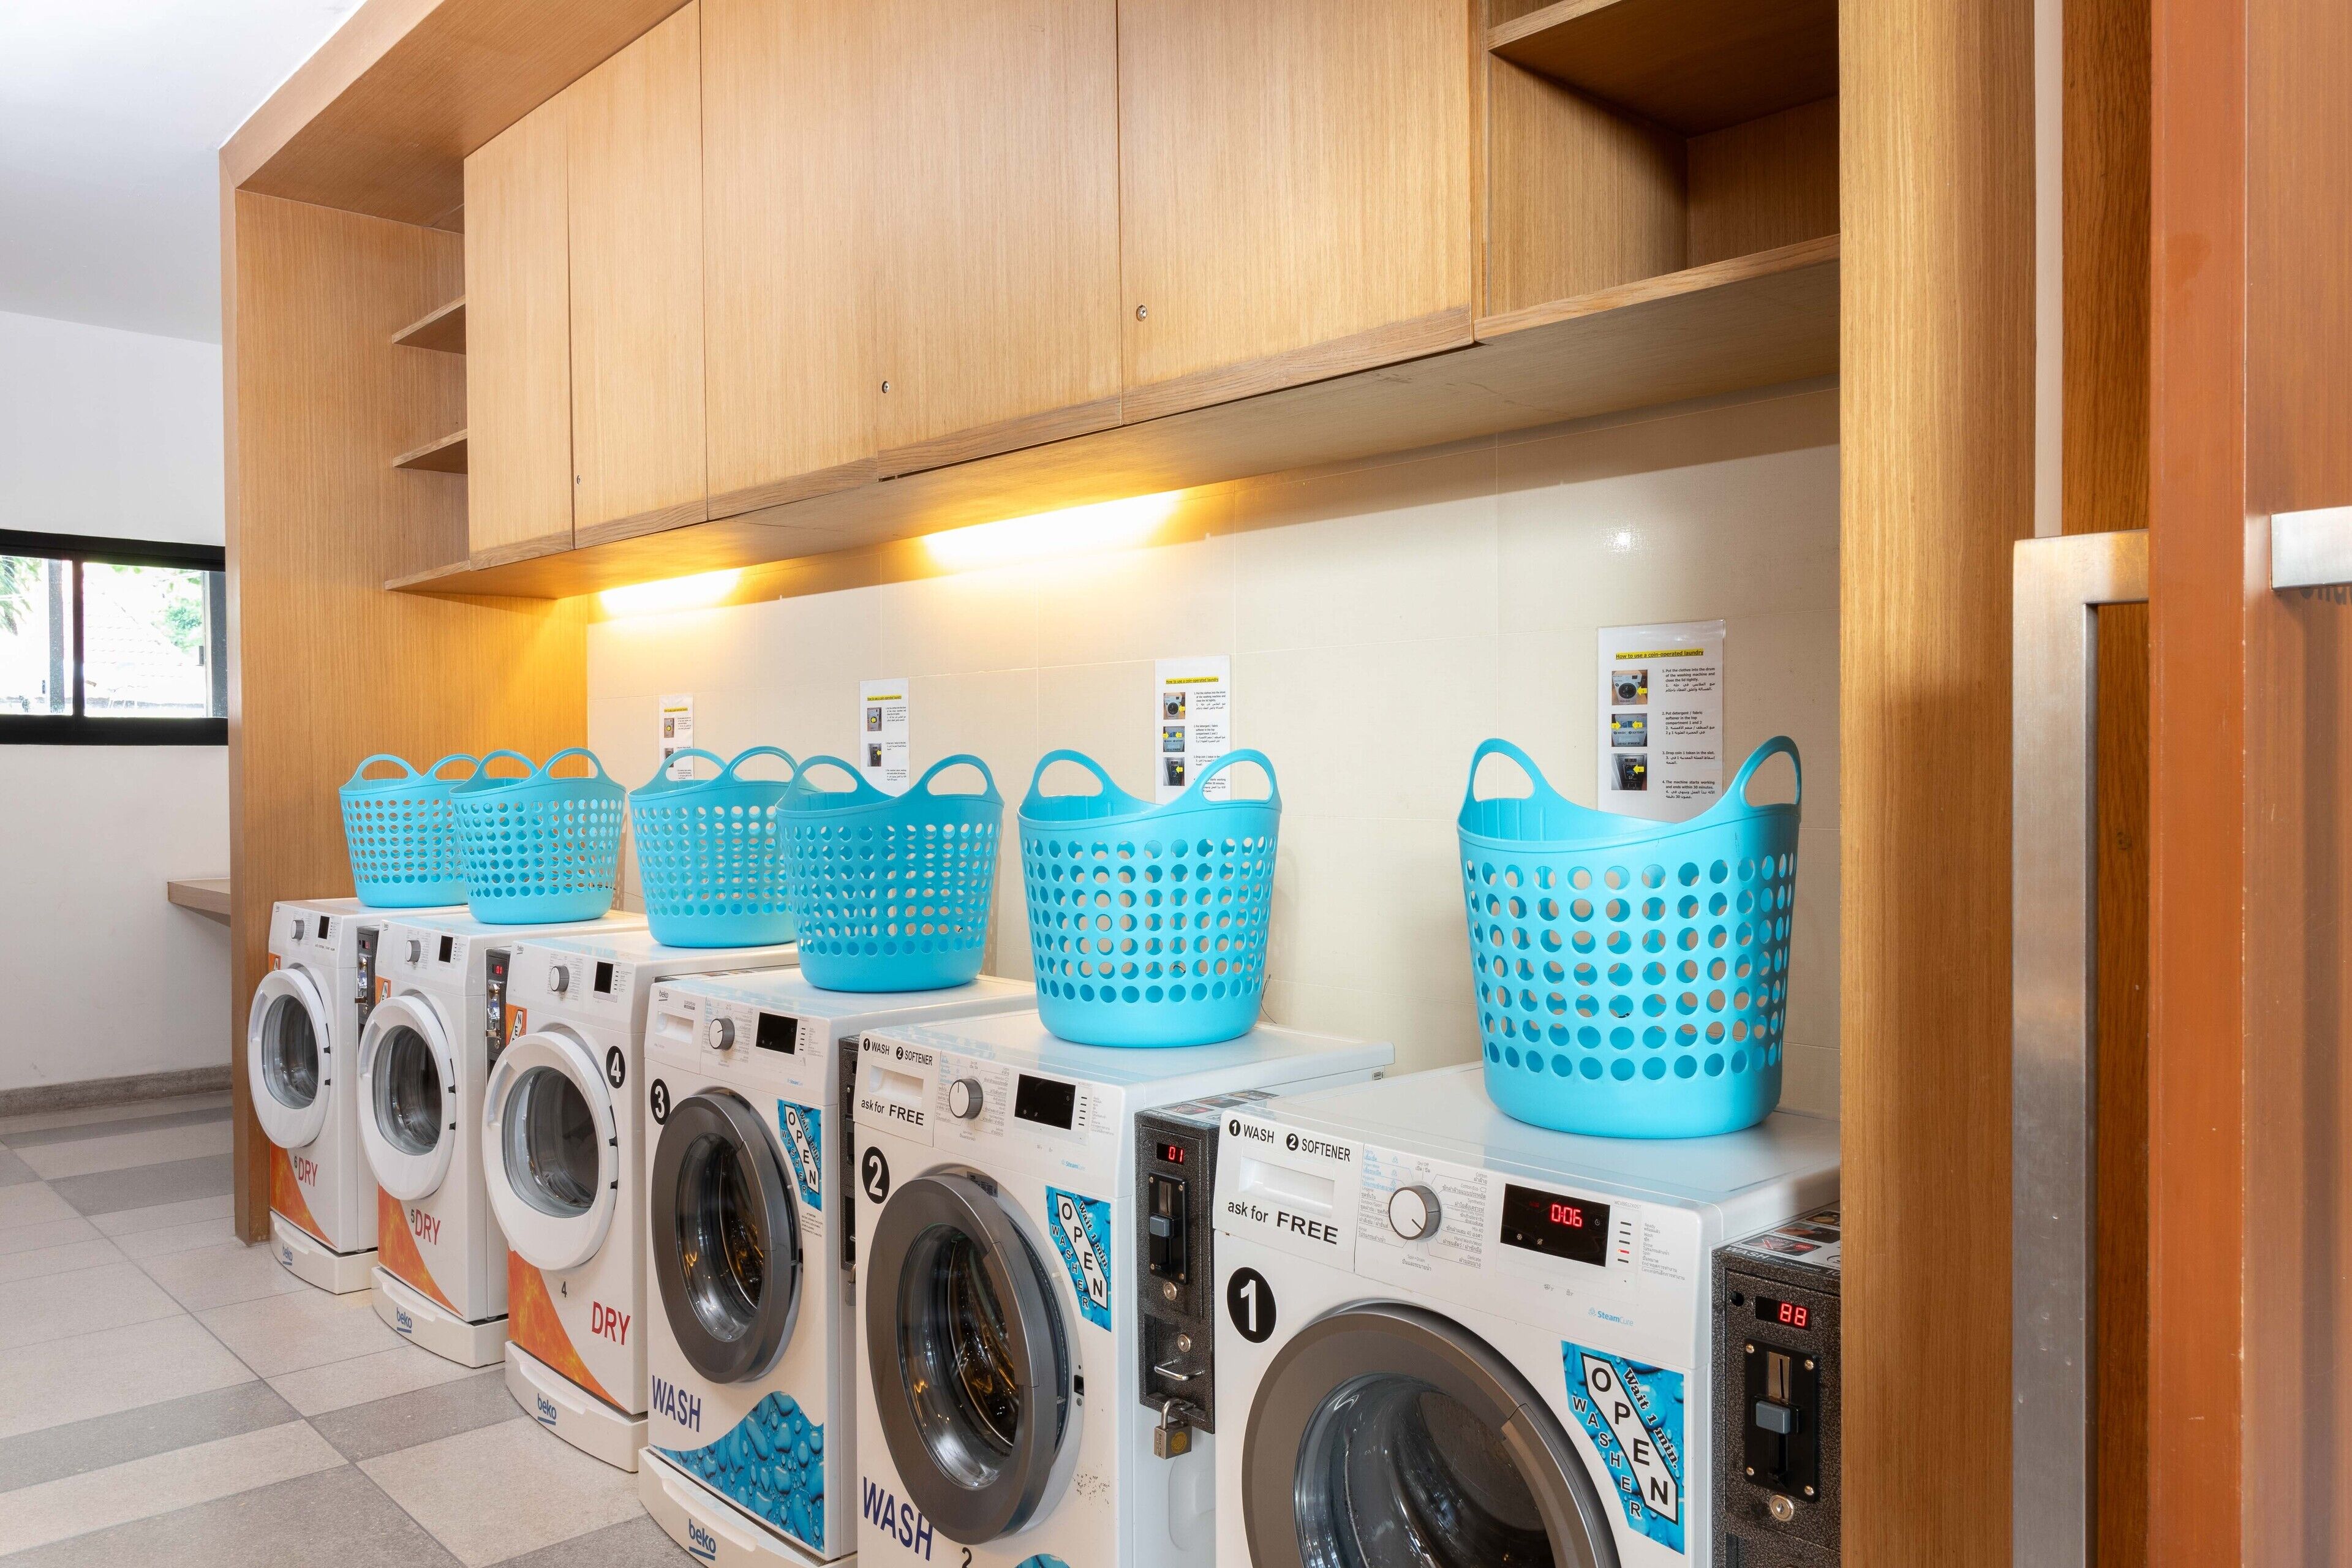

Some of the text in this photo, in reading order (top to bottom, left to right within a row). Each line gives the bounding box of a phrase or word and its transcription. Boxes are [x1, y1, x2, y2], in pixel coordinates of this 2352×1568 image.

[659, 989, 669, 998] beko
[872, 1041, 890, 1055] WASH
[905, 1050, 933, 1066] SOFTENER
[861, 1099, 924, 1126] ask for FREE
[788, 1112, 816, 1185] OPEN
[1169, 1146, 1183, 1163] 01
[1243, 1124, 1275, 1144] WASH
[1302, 1138, 1351, 1163] SOFTENER
[294, 1155, 318, 1187] 6 DRY
[410, 1208, 441, 1245] 5 DRY
[1227, 1201, 1248, 1218] ask
[1251, 1205, 1268, 1223] for
[1276, 1210, 1338, 1245] FREE
[1551, 1204, 1583, 1227] 0:06
[282, 1246, 293, 1262] beko
[1061, 1202, 1102, 1298] OPEN
[1079, 1201, 1093, 1231] Wait
[1095, 1242, 1109, 1272] min.
[1725, 1247, 1770, 1259] WASH
[1052, 1224, 1088, 1308] WASHER
[397, 1307, 412, 1329] beko
[561, 1281, 631, 1346] 4 DRY
[1597, 1310, 1634, 1327] SteamCure
[1779, 1303, 1807, 1327] 88
[538, 1393, 557, 1420] beko
[652, 1375, 701, 1432] WASH
[1623, 1368, 1678, 1469] Wait 1 min.
[1592, 1367, 1668, 1506] OPEN
[1572, 1396, 1642, 1518] WASHER
[689, 1518, 717, 1554] beko
[864, 1476, 933, 1561] WASH
